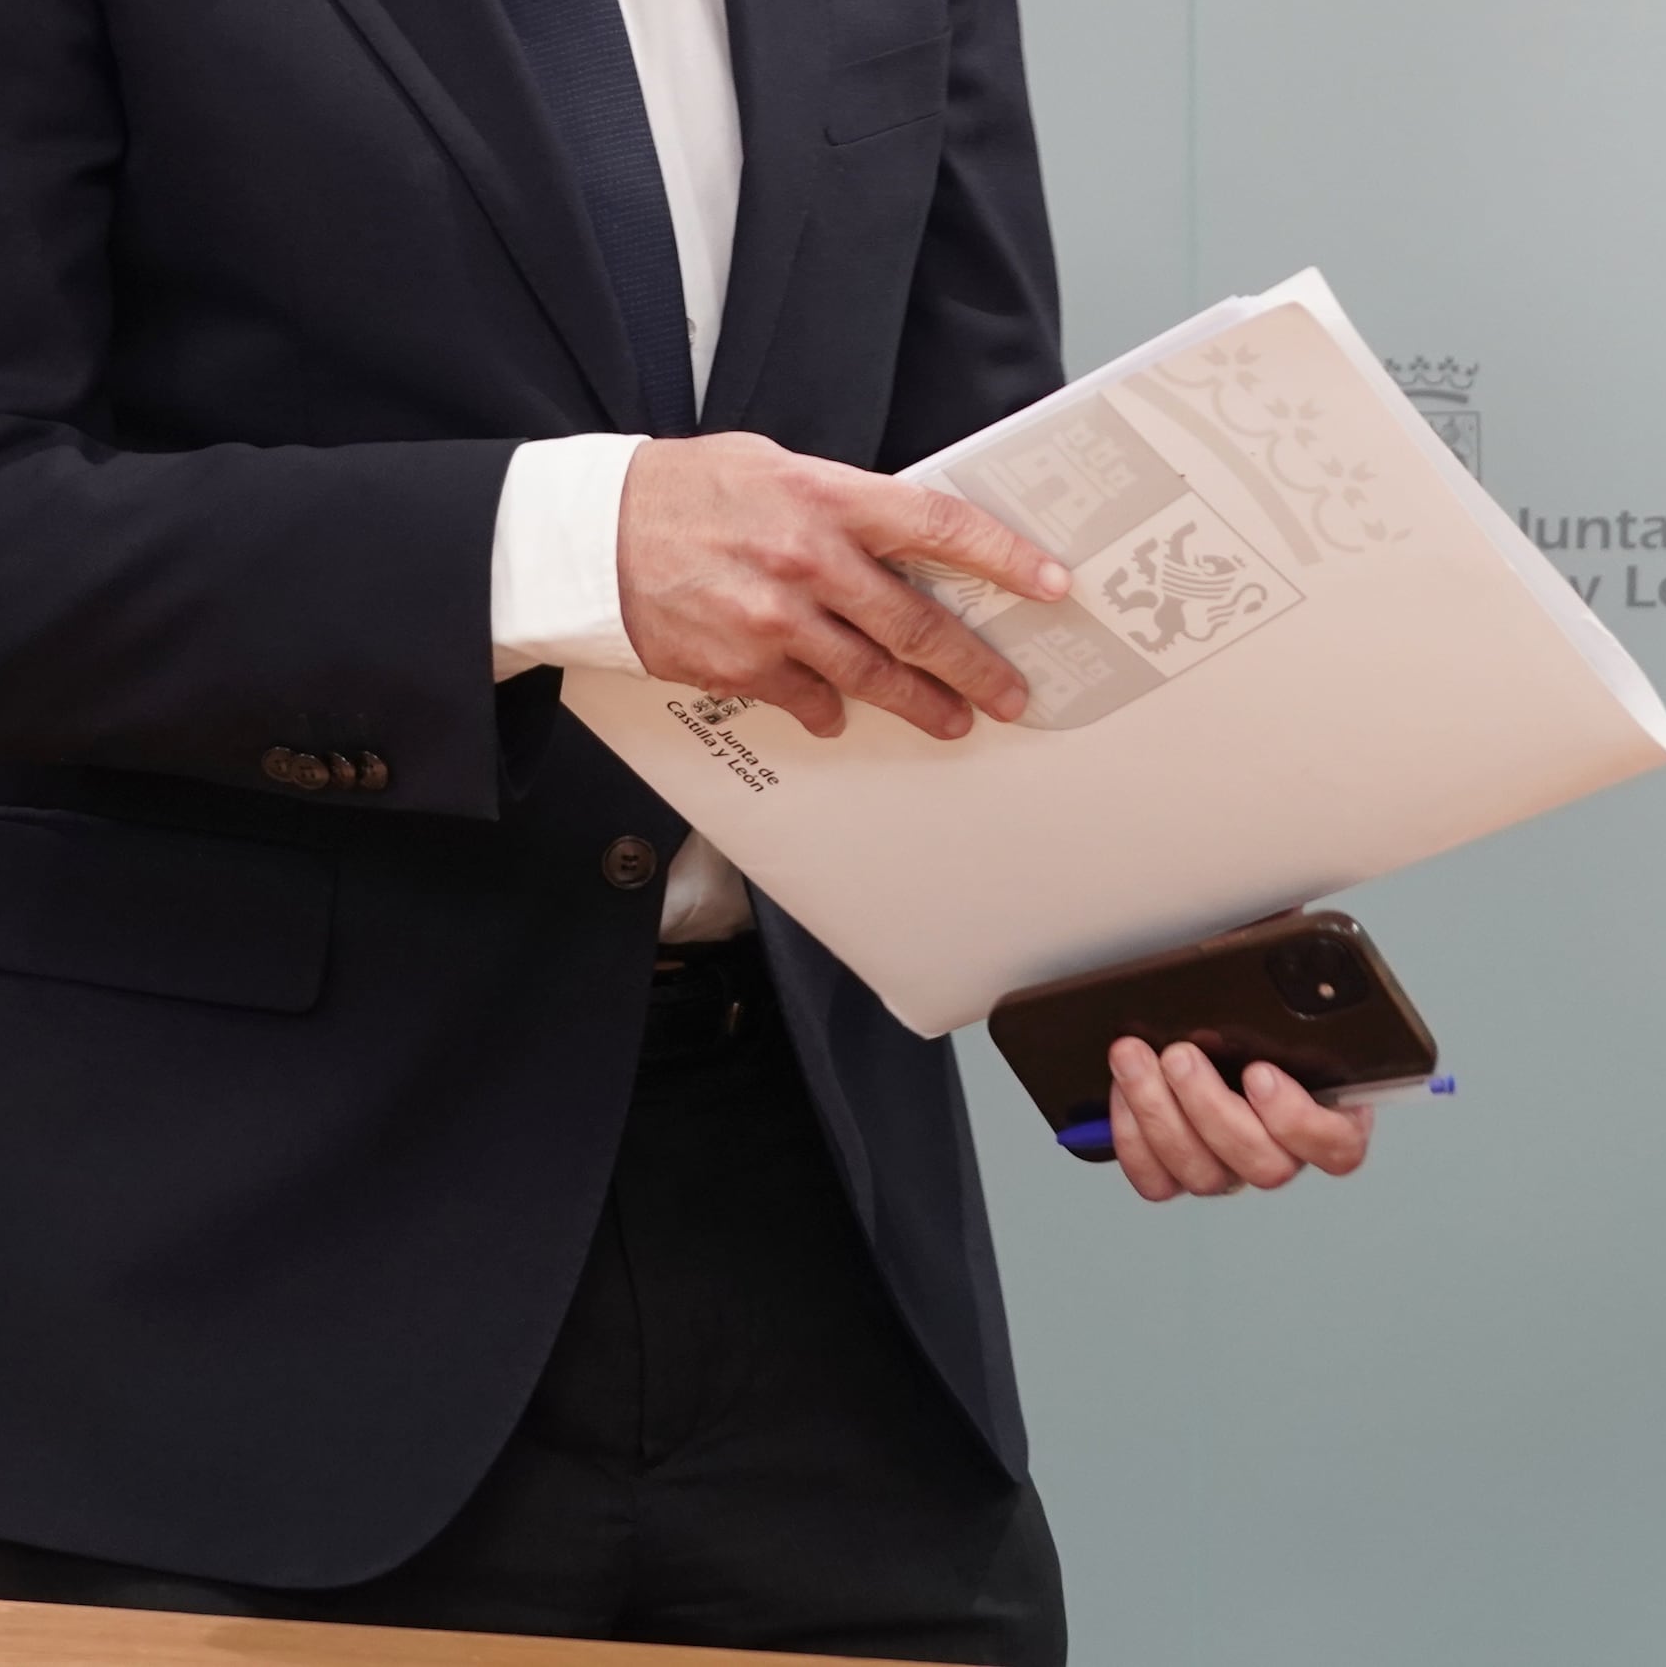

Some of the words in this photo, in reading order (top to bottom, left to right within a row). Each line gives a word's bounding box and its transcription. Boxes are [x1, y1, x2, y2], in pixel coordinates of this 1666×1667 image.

[666, 700, 717, 748] Castilla
[710, 747, 730, 759] y
[727, 758, 765, 793] León
[716, 729, 759, 766] Junta
[758, 765, 779, 786] de
